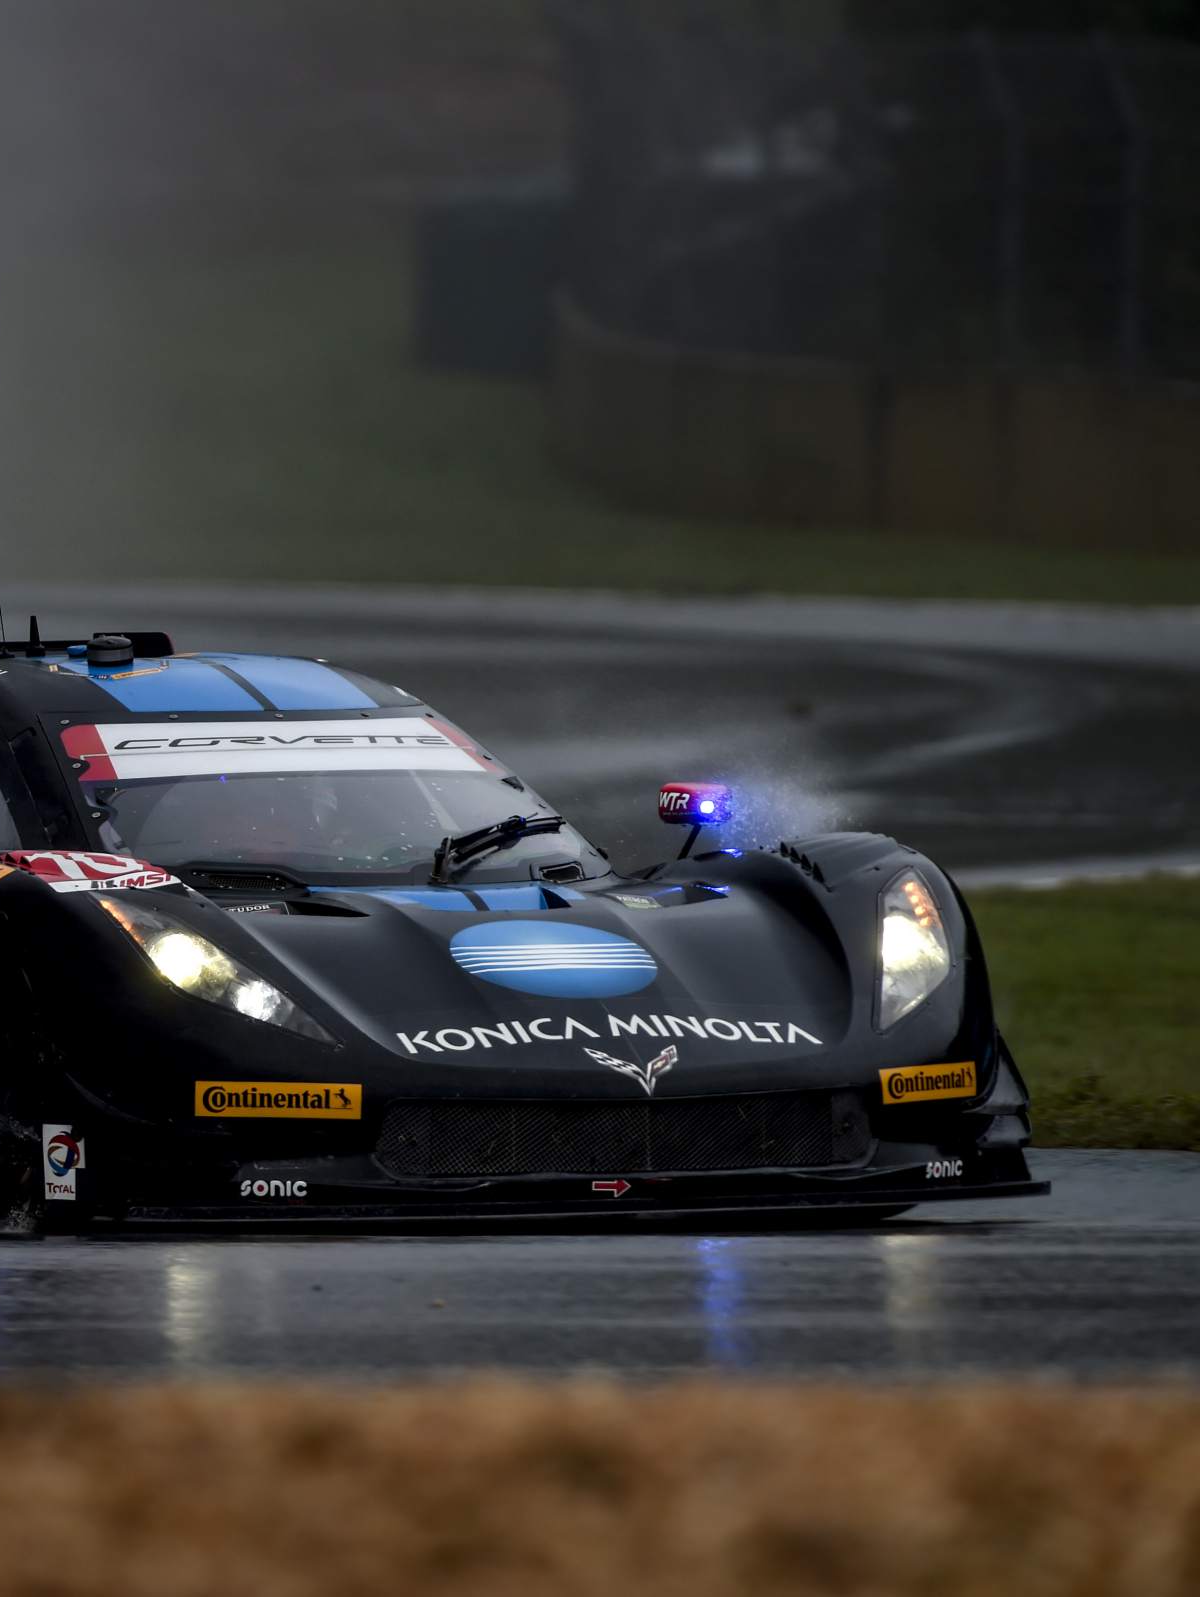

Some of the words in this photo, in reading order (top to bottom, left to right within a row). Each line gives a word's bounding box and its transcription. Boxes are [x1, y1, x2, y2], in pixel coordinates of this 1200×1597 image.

[114, 735, 450, 750] CORVETTE
[659, 791, 690, 811] WTR
[228, 904, 271, 913] TUDOR
[396, 1016, 600, 1054] KONICA
[607, 1014, 823, 1044] MINOLTA
[888, 1068, 965, 1099] Continental
[202, 1086, 331, 1113] Continental
